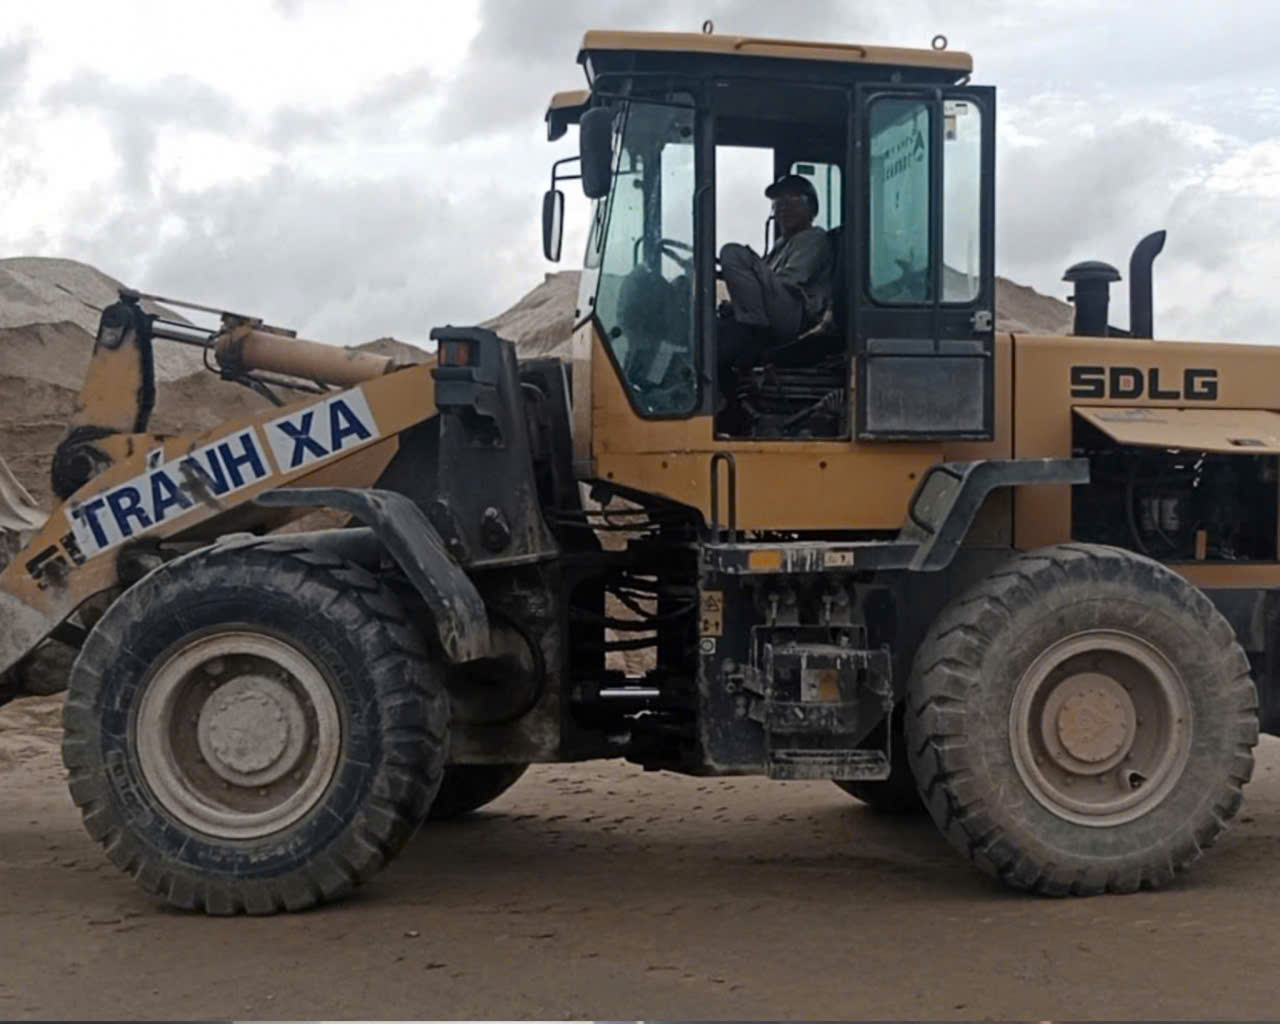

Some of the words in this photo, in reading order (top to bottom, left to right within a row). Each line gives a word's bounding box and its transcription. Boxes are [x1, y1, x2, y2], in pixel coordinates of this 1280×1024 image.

[1070, 365, 1218, 401] SDLG
[72, 427, 267, 550] TRÁNH
[277, 399, 373, 469] XA
